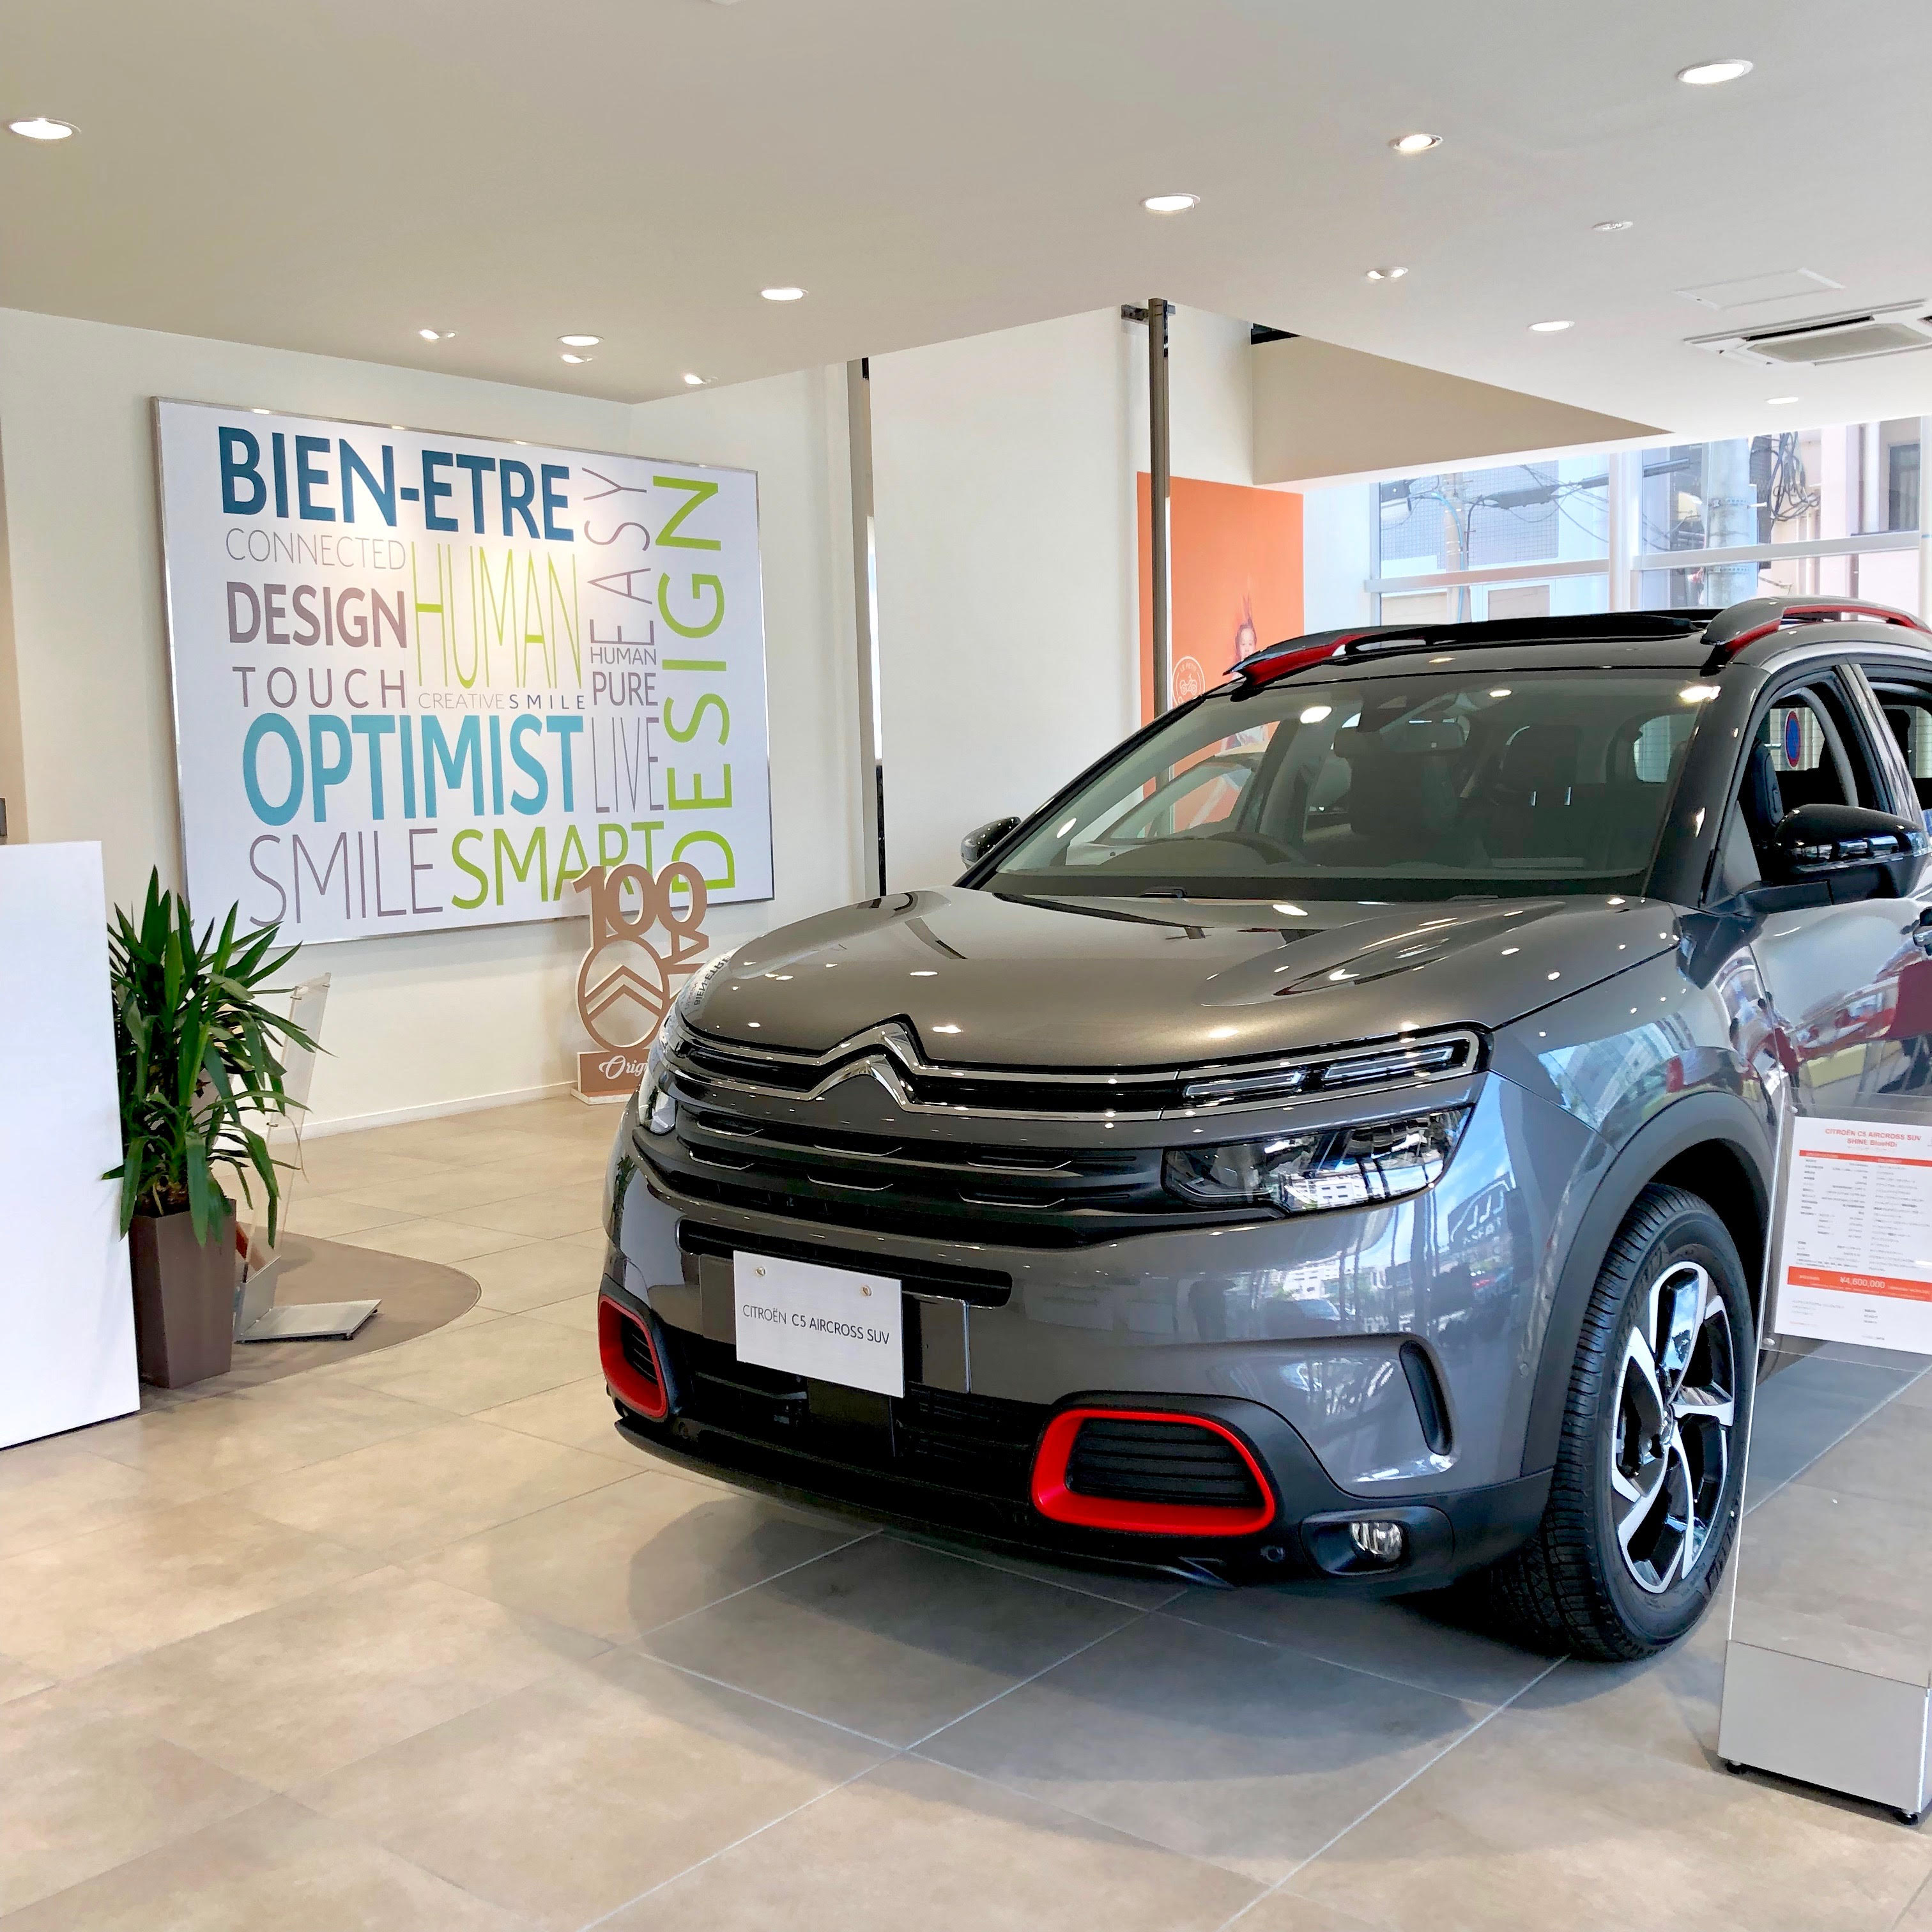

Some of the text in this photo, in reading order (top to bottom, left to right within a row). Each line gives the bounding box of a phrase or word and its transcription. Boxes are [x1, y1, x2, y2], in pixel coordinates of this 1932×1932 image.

[218, 425, 574, 542] BIEN-ETRE
[226, 528, 406, 571] CONNECTED
[582, 467, 655, 646] EASY
[226, 581, 408, 648] DESIGN
[411, 540, 582, 689] HUMAN
[232, 666, 406, 709] TOUCH
[590, 647, 657, 666] HUMAN
[592, 671, 659, 707] PURE
[653, 475, 735, 894] DESIGN
[418, 693, 505, 710] CREATIVE
[509, 694, 585, 710] SMILE
[243, 712, 584, 826] OPTIMIST
[591, 716, 665, 813] LIVE
[249, 827, 443, 928] SMILE
[451, 820, 664, 910] SMART
[571, 861, 709, 949] 100
[1868, 1131, 1905, 1140] AIRCROSS
[742, 1304, 890, 1345] CITROËN C5 AIRCROSS SUV
